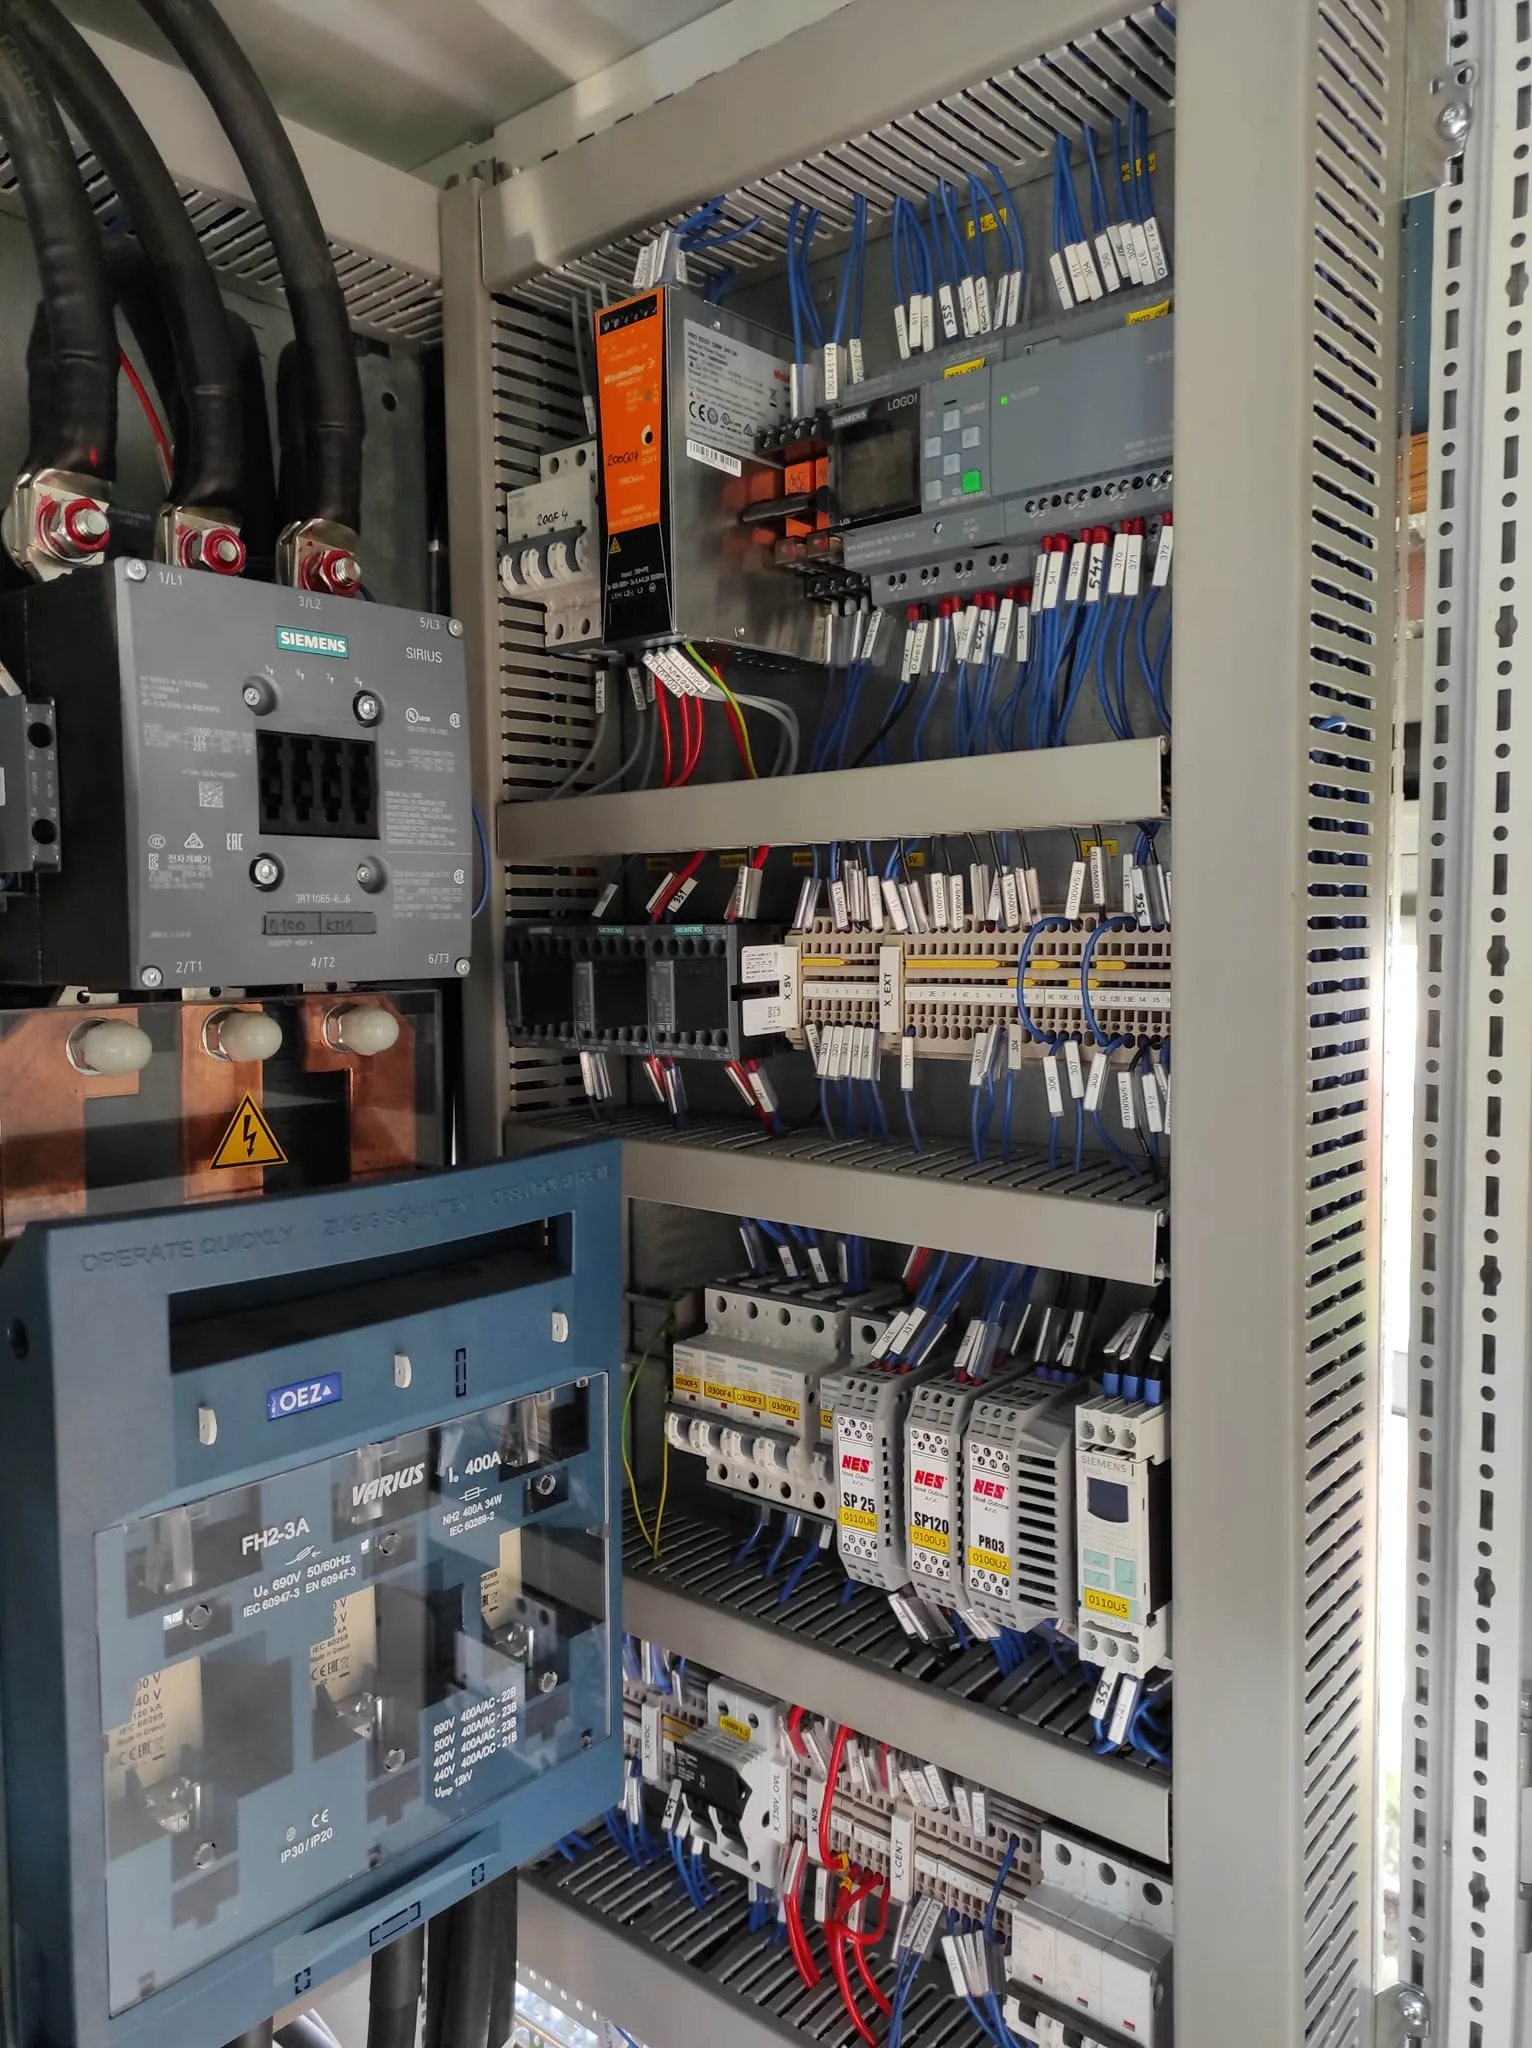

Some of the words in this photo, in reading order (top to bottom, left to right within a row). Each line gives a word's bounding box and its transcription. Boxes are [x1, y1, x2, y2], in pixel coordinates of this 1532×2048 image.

[1114, 552, 1124, 568] 370
[1128, 554, 1137, 569] 371
[1160, 545, 1169, 560] 372
[159, 572, 183, 586] 1/L1
[1048, 571, 1056, 584] 541
[1089, 556, 1103, 589] 541
[298, 596, 322, 610] 3/L2
[419, 617, 441, 631] 5/L3
[280, 631, 346, 654] SIEMENS
[406, 646, 443, 664] SIRIUS
[227, 833, 243, 850] EAC
[674, 926, 702, 935] SIEMENS
[705, 926, 727, 935] SIRIUS
[176, 960, 202, 974] 2/T1
[311, 957, 335, 968] 4/T2
[428, 954, 449, 964] 6/T3
[784, 975, 792, 1000] X_SV
[884, 973, 893, 1007] X_EXT
[1071, 1060, 1079, 1075] 307
[1089, 1073, 1098, 1089] 309
[80, 1240, 195, 1272] OPERATE
[201, 1225, 295, 1255] QUICKLY
[675, 1377, 698, 1389] 0300F5
[707, 1386, 732, 1398] 0300F4
[279, 1382, 322, 1411] OEZ
[736, 1394, 762, 1406] 0300F3
[771, 1402, 797, 1414] 0300F2
[465, 1451, 501, 1476] 400A
[842, 1455, 870, 1473] NES
[1081, 1455, 1127, 1473] SIEMENS
[352, 1462, 425, 1506] VARIUS
[914, 1470, 944, 1489] NES
[973, 1479, 1005, 1499] NES
[442, 1508, 460, 1526] NH2
[463, 1503, 483, 1518] 400A
[484, 1493, 503, 1510] 34W
[843, 1492, 857, 1508] SP
[861, 1496, 875, 1513] 25
[449, 1524, 463, 1537] IEC
[464, 1511, 495, 1530] 60269-2
[843, 1512, 875, 1527] 0110U6
[914, 1512, 949, 1535] SP120
[242, 1518, 310, 1555] FH2-3A
[913, 1531, 946, 1547] 0100U3
[972, 1553, 1007, 1571] 0100U2
[272, 1571, 301, 1591] 690V
[307, 1554, 352, 1577] 50/60Hz
[243, 1603, 261, 1618] IEC
[262, 1587, 300, 1610] 60947-3
[305, 1580, 319, 1593] EN
[321, 1566, 356, 1588] 60947-3
[153, 1688, 162, 1700] V
[1096, 1681, 1112, 1706] 352
[433, 1717, 455, 1736] 690V
[461, 1697, 495, 1722] 400A/AC
[501, 1686, 517, 1700] 22B
[461, 1712, 496, 1738] 400A/AC
[501, 1701, 517, 1717] 23B
[433, 1748, 456, 1767] 400V
[461, 1727, 496, 1753] 400A/AC
[501, 1717, 517, 1733] 23B
[433, 1763, 456, 1782] 440V
[461, 1743, 496, 1768] 400A/DC
[502, 1731, 518, 1748] 21B
[312, 1809, 329, 1828] CE
